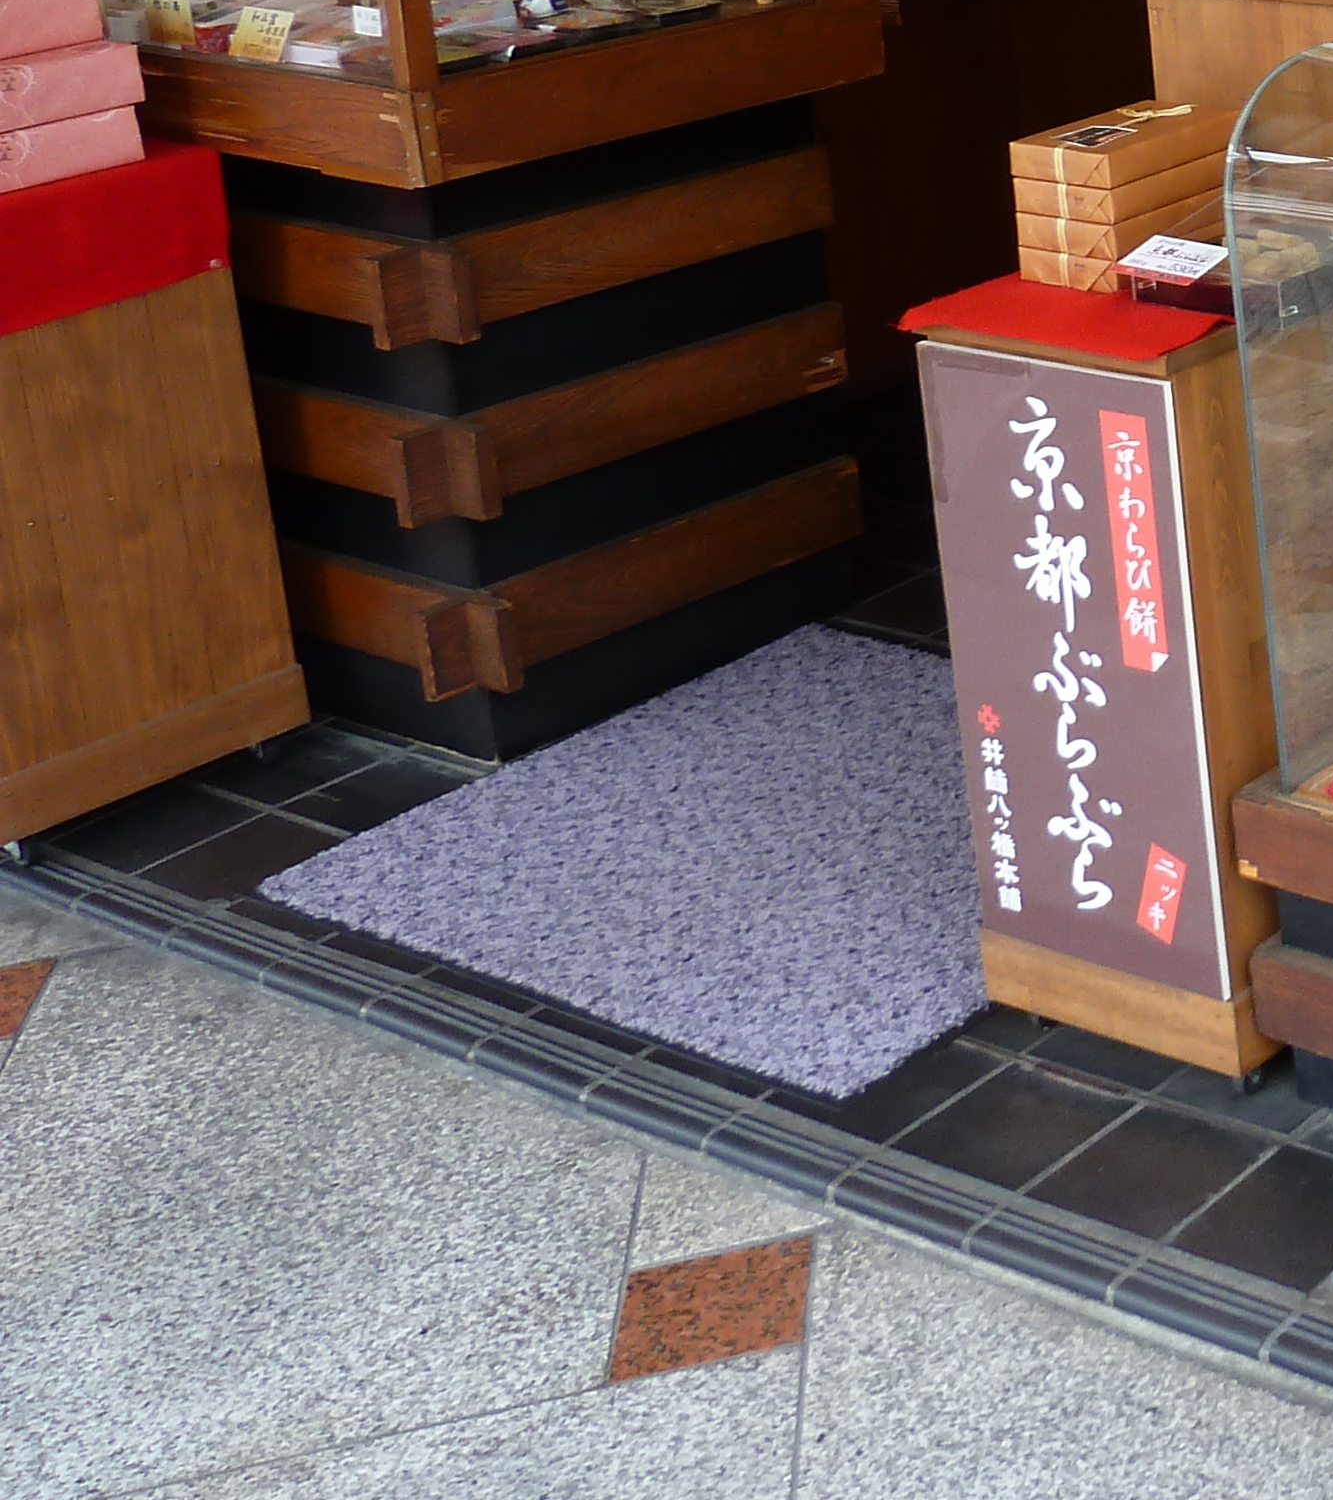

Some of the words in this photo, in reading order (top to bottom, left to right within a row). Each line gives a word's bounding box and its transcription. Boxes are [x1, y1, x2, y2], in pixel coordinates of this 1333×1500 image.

[1108, 431, 1157, 645] 京わらび餅
[1008, 395, 1124, 911] 京都ぶらぶら
[1146, 856, 1181, 932] ニッキ
